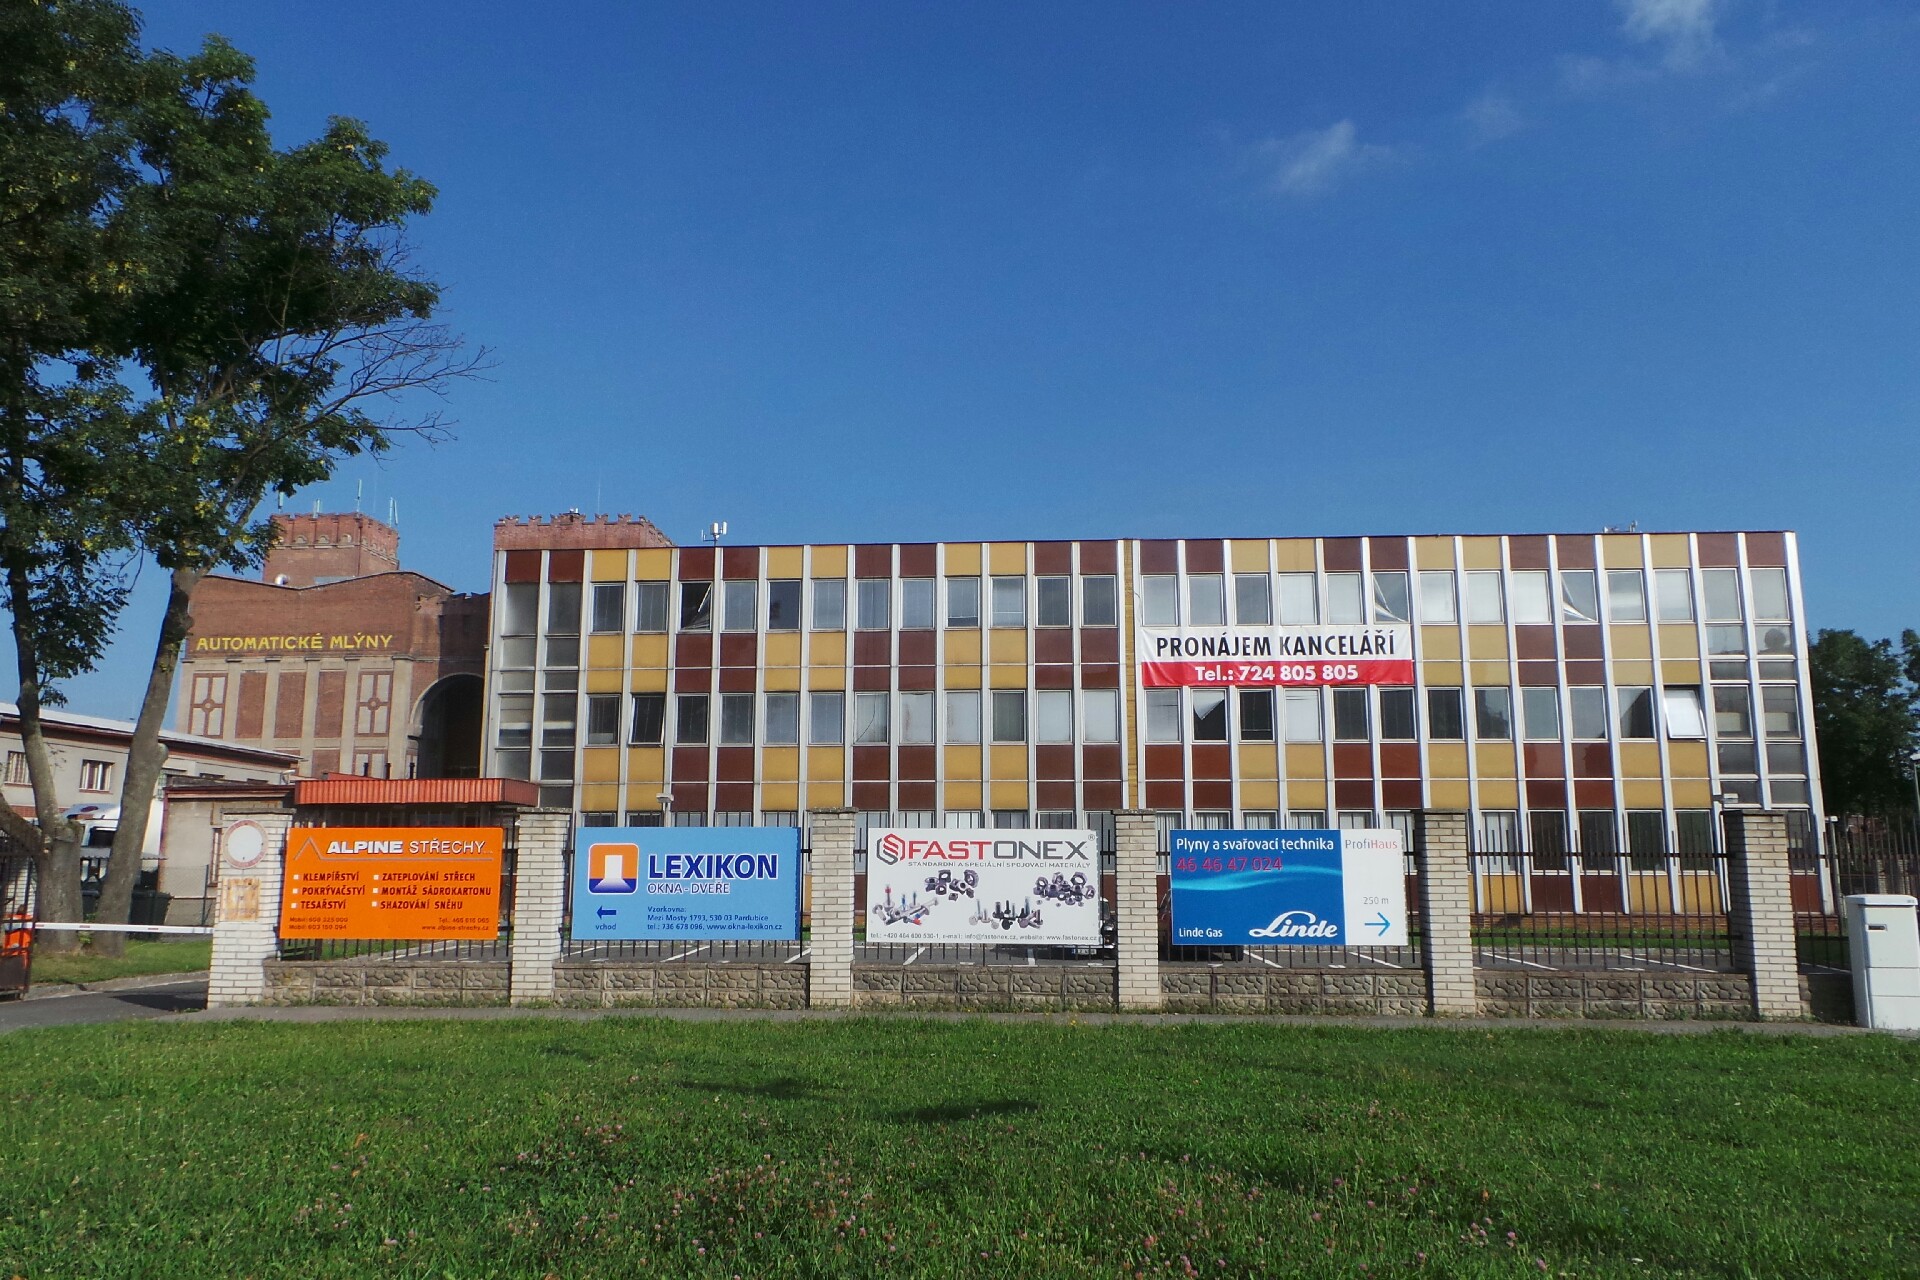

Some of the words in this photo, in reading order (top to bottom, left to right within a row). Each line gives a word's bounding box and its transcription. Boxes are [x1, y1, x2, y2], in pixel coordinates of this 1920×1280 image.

[196, 633, 323, 650] AUTOMATICKÉ
[329, 632, 393, 649] MLÝNY
[1156, 632, 1271, 657] PRONÁJEM
[1279, 629, 1395, 656] KANCELÁŘÍ
[1195, 666, 1234, 682] Tel.:
[1238, 665, 1275, 682] 724
[1280, 665, 1316, 681] 805
[1322, 664, 1358, 680] 805
[326, 841, 403, 854] ALPINE
[409, 838, 485, 854] STŘECHY
[908, 840, 1089, 860] FASTONEX
[1176, 838, 1210, 853] Plyny
[1212, 841, 1220, 850] a
[1223, 838, 1279, 850] svařovací
[1281, 838, 1334, 850] technika
[1345, 838, 1398, 850] ProfiHaus
[648, 854, 778, 879] LEXIKON
[1175, 857, 1197, 872] 46
[1202, 857, 1222, 872] 46
[1227, 857, 1247, 872] 47
[1251, 857, 1283, 872] 024
[303, 871, 359, 881] KLEMPÍŘSTVÍ
[382, 871, 439, 881] ZATEPLOVÁNÍ
[443, 871, 475, 881] STŘECH
[302, 885, 365, 896] POKRÝVAČSTVÍ
[381, 885, 417, 895] MONTÁŽ
[422, 885, 491, 896] SÁDROKARTONU
[300, 899, 346, 910] TESAŘSTVÍ
[380, 899, 430, 910] SHAZOVÁNÍ
[434, 899, 463, 910] SNĚHU
[1363, 896, 1380, 905] 250
[1381, 897, 1389, 905] m
[665, 914, 688, 923] Mosty
[689, 914, 708, 922] 1793,
[1249, 910, 1338, 938] Linde
[1179, 928, 1204, 938] Linde
[1206, 928, 1223, 938] Gas
